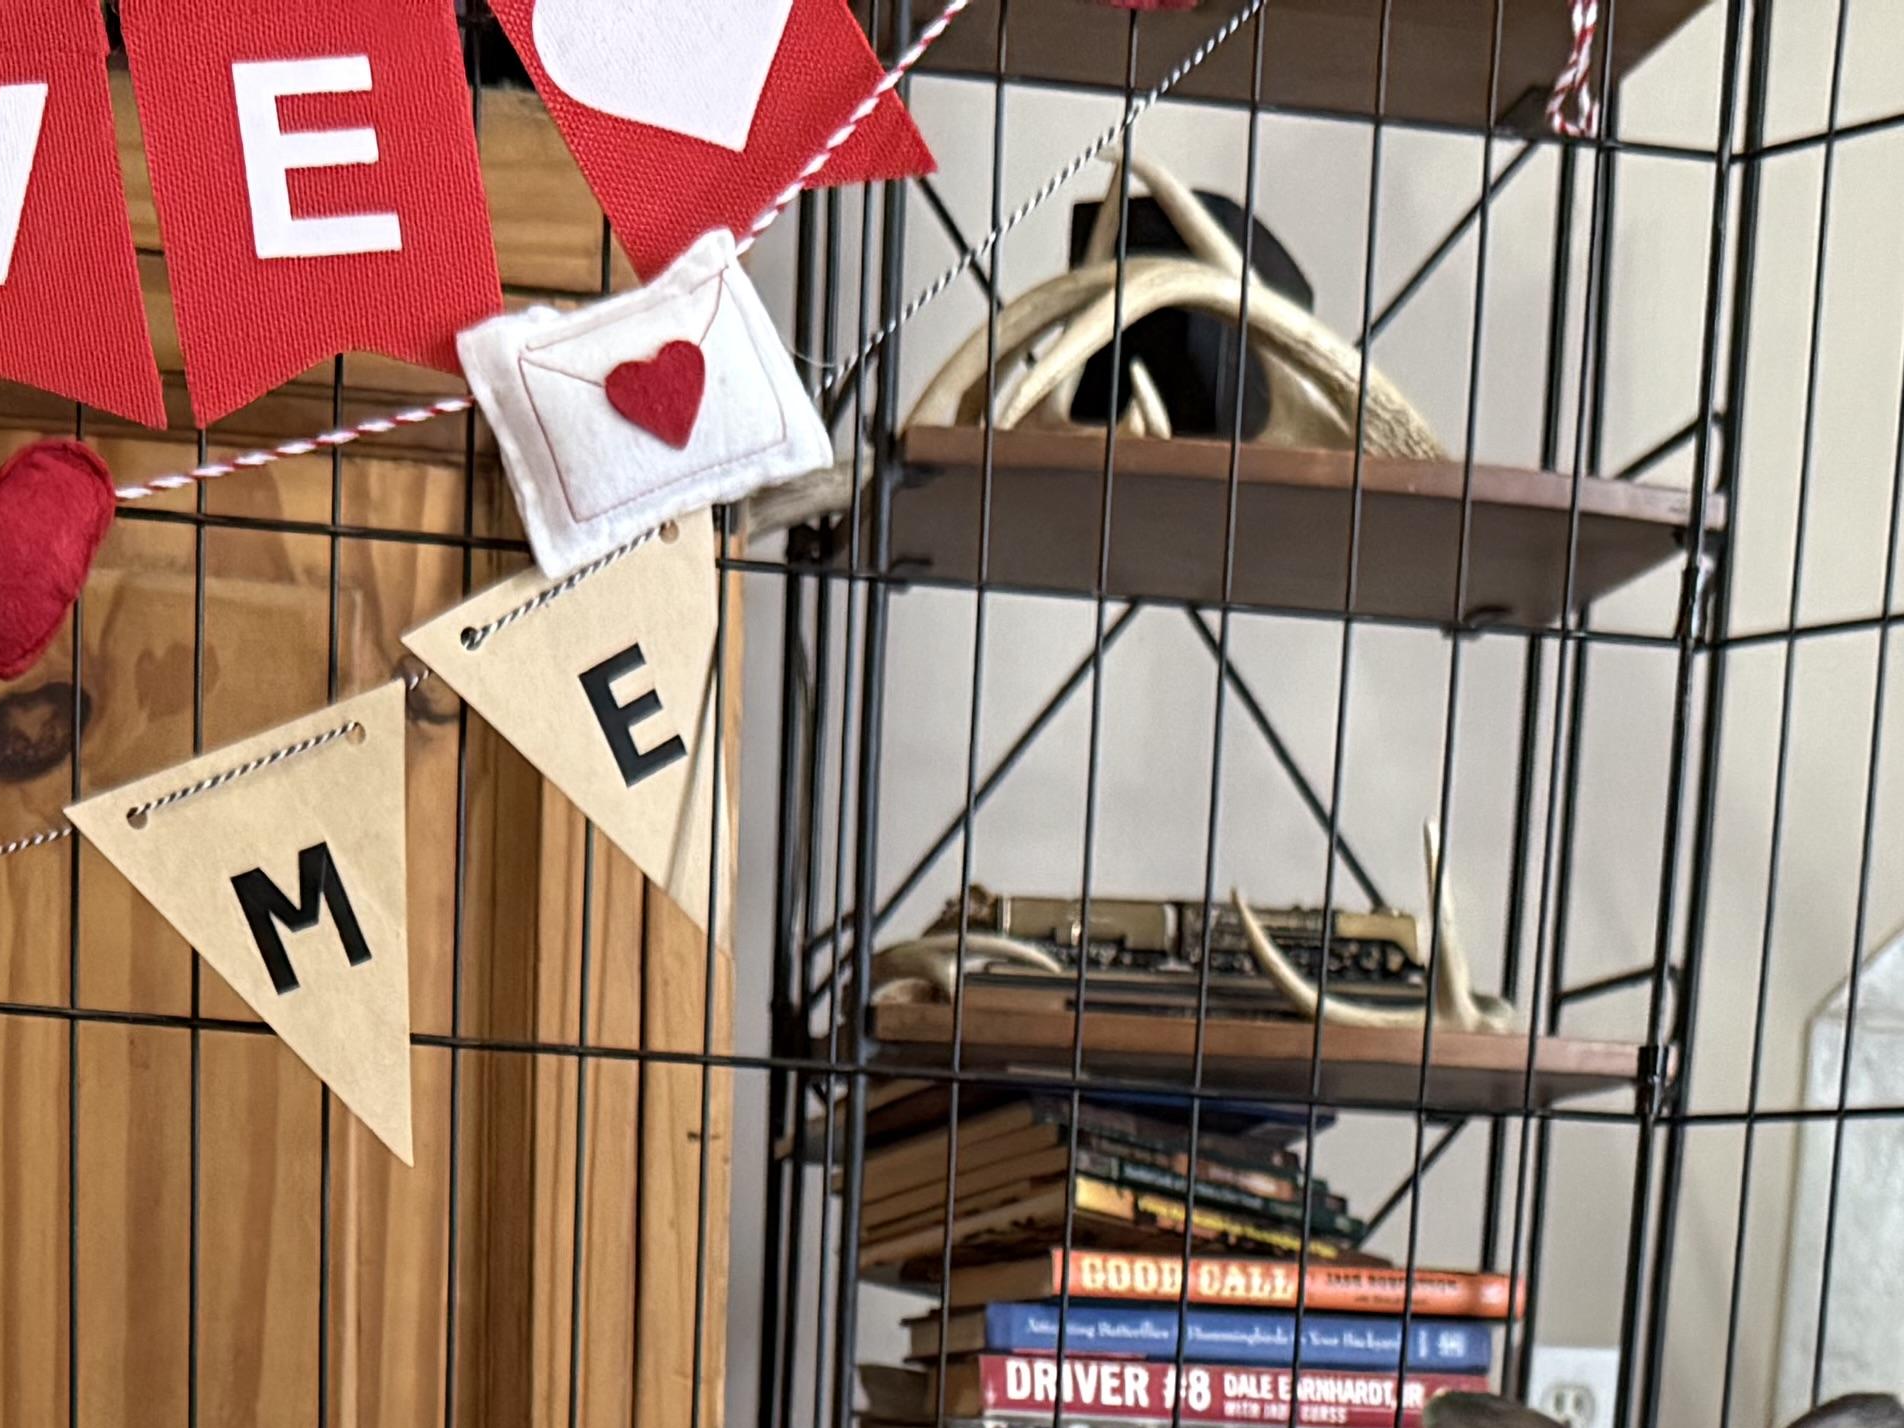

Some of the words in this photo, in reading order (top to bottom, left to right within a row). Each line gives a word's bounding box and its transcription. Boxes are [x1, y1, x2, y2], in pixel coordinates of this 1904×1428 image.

[229, 641, 688, 996] ME
[1080, 1256, 1183, 1293] GOOD
[1198, 1265, 1295, 1301] CALL
[1005, 1359, 1150, 1407] DRIVER
[1162, 1366, 1212, 1412] #8
[1223, 1373, 1274, 1399] DALE
[1223, 1401, 1261, 1418] WITH
